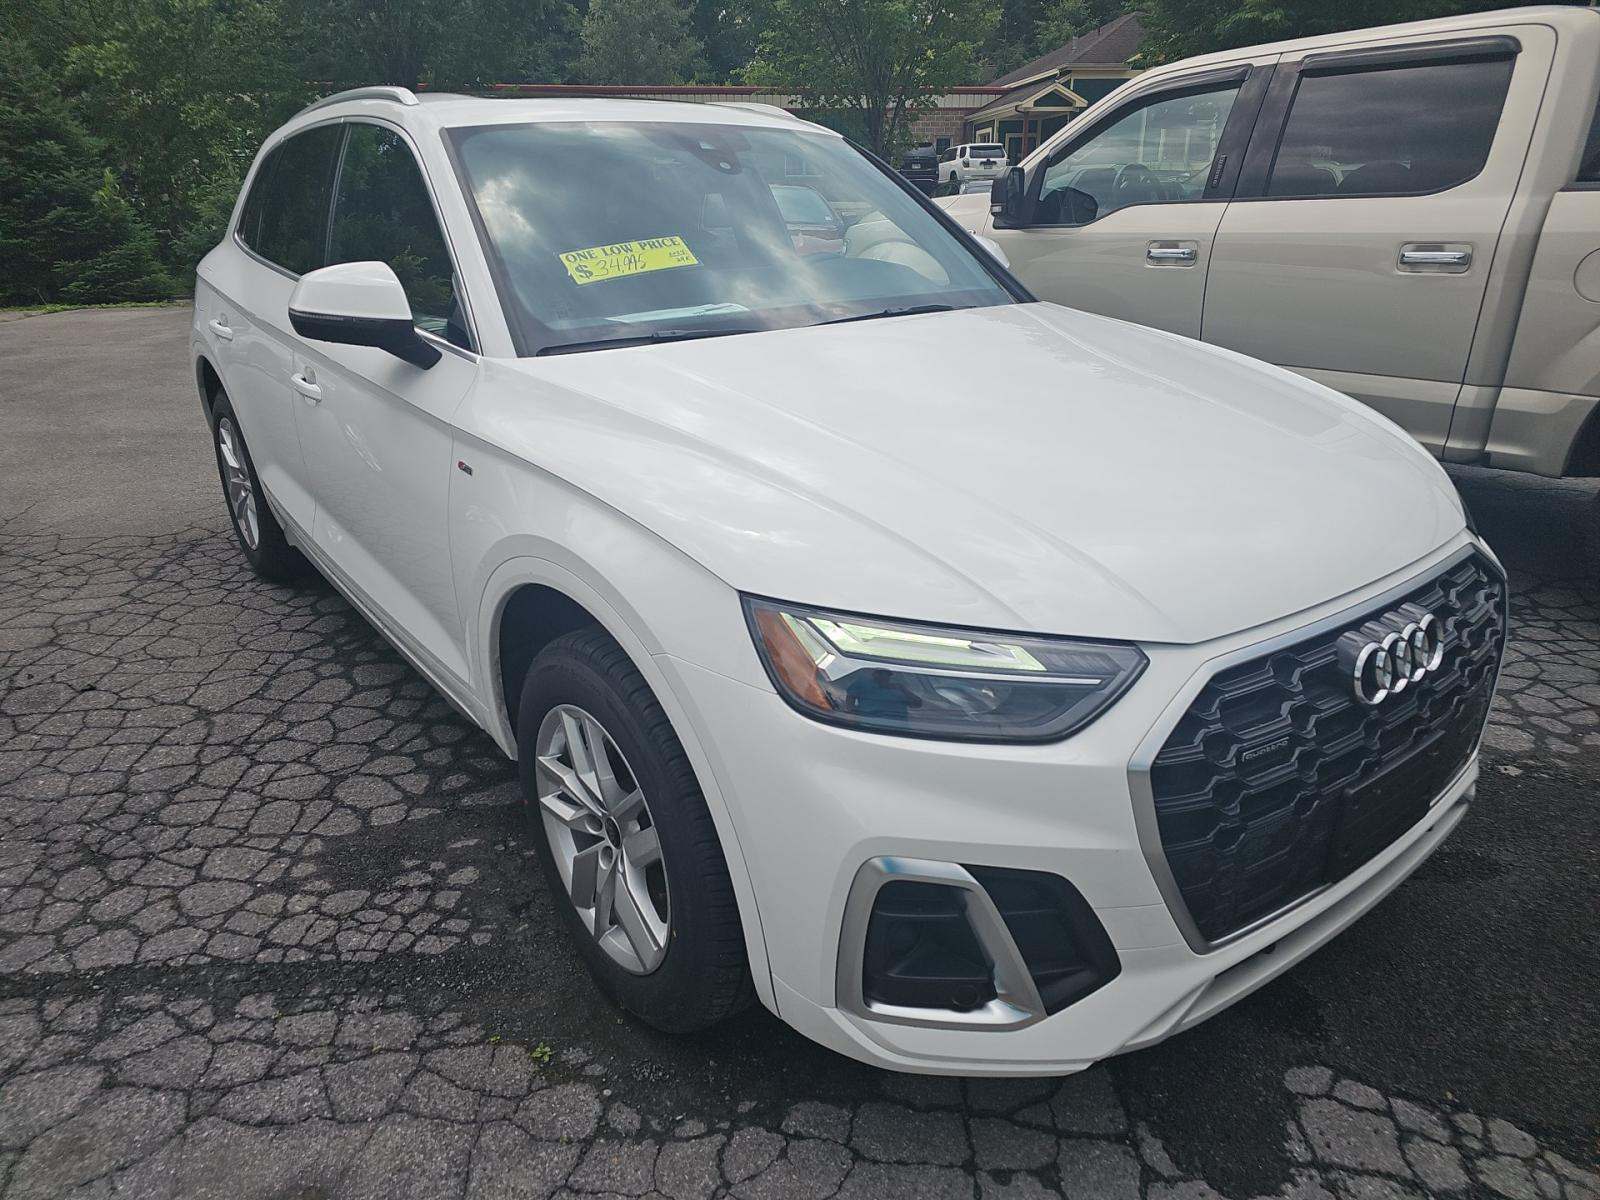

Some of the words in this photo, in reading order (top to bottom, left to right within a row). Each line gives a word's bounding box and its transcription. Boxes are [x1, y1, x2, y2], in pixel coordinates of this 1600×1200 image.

[566, 250, 598, 263] ONE
[603, 244, 633, 257] LOW
[638, 238, 680, 251] PRICE
